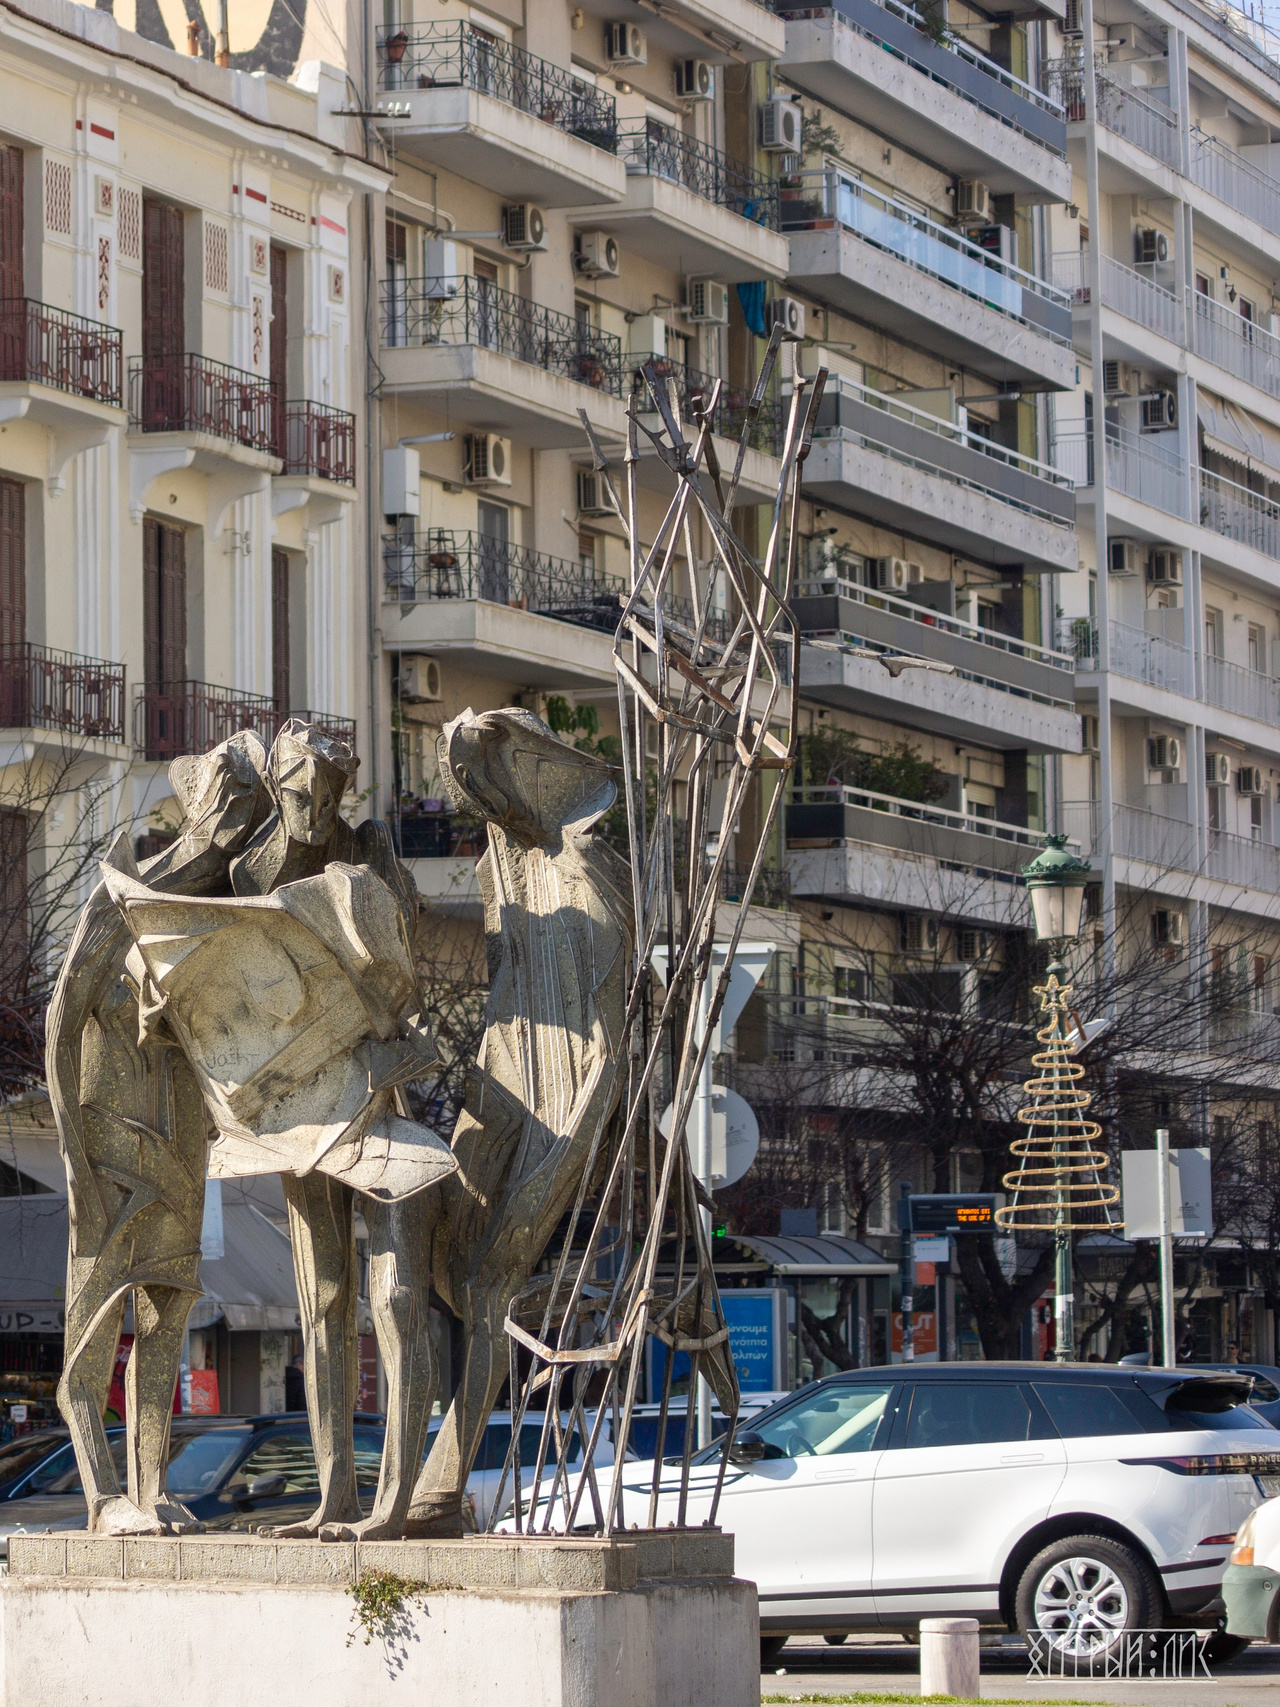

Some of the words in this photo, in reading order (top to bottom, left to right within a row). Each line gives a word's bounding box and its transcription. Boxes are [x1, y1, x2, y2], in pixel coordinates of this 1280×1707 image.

[728, 1324, 767, 1335] ώνουμε
[730, 1337, 767, 1346] ινότητα
[732, 1350, 767, 1359] ολιτών
